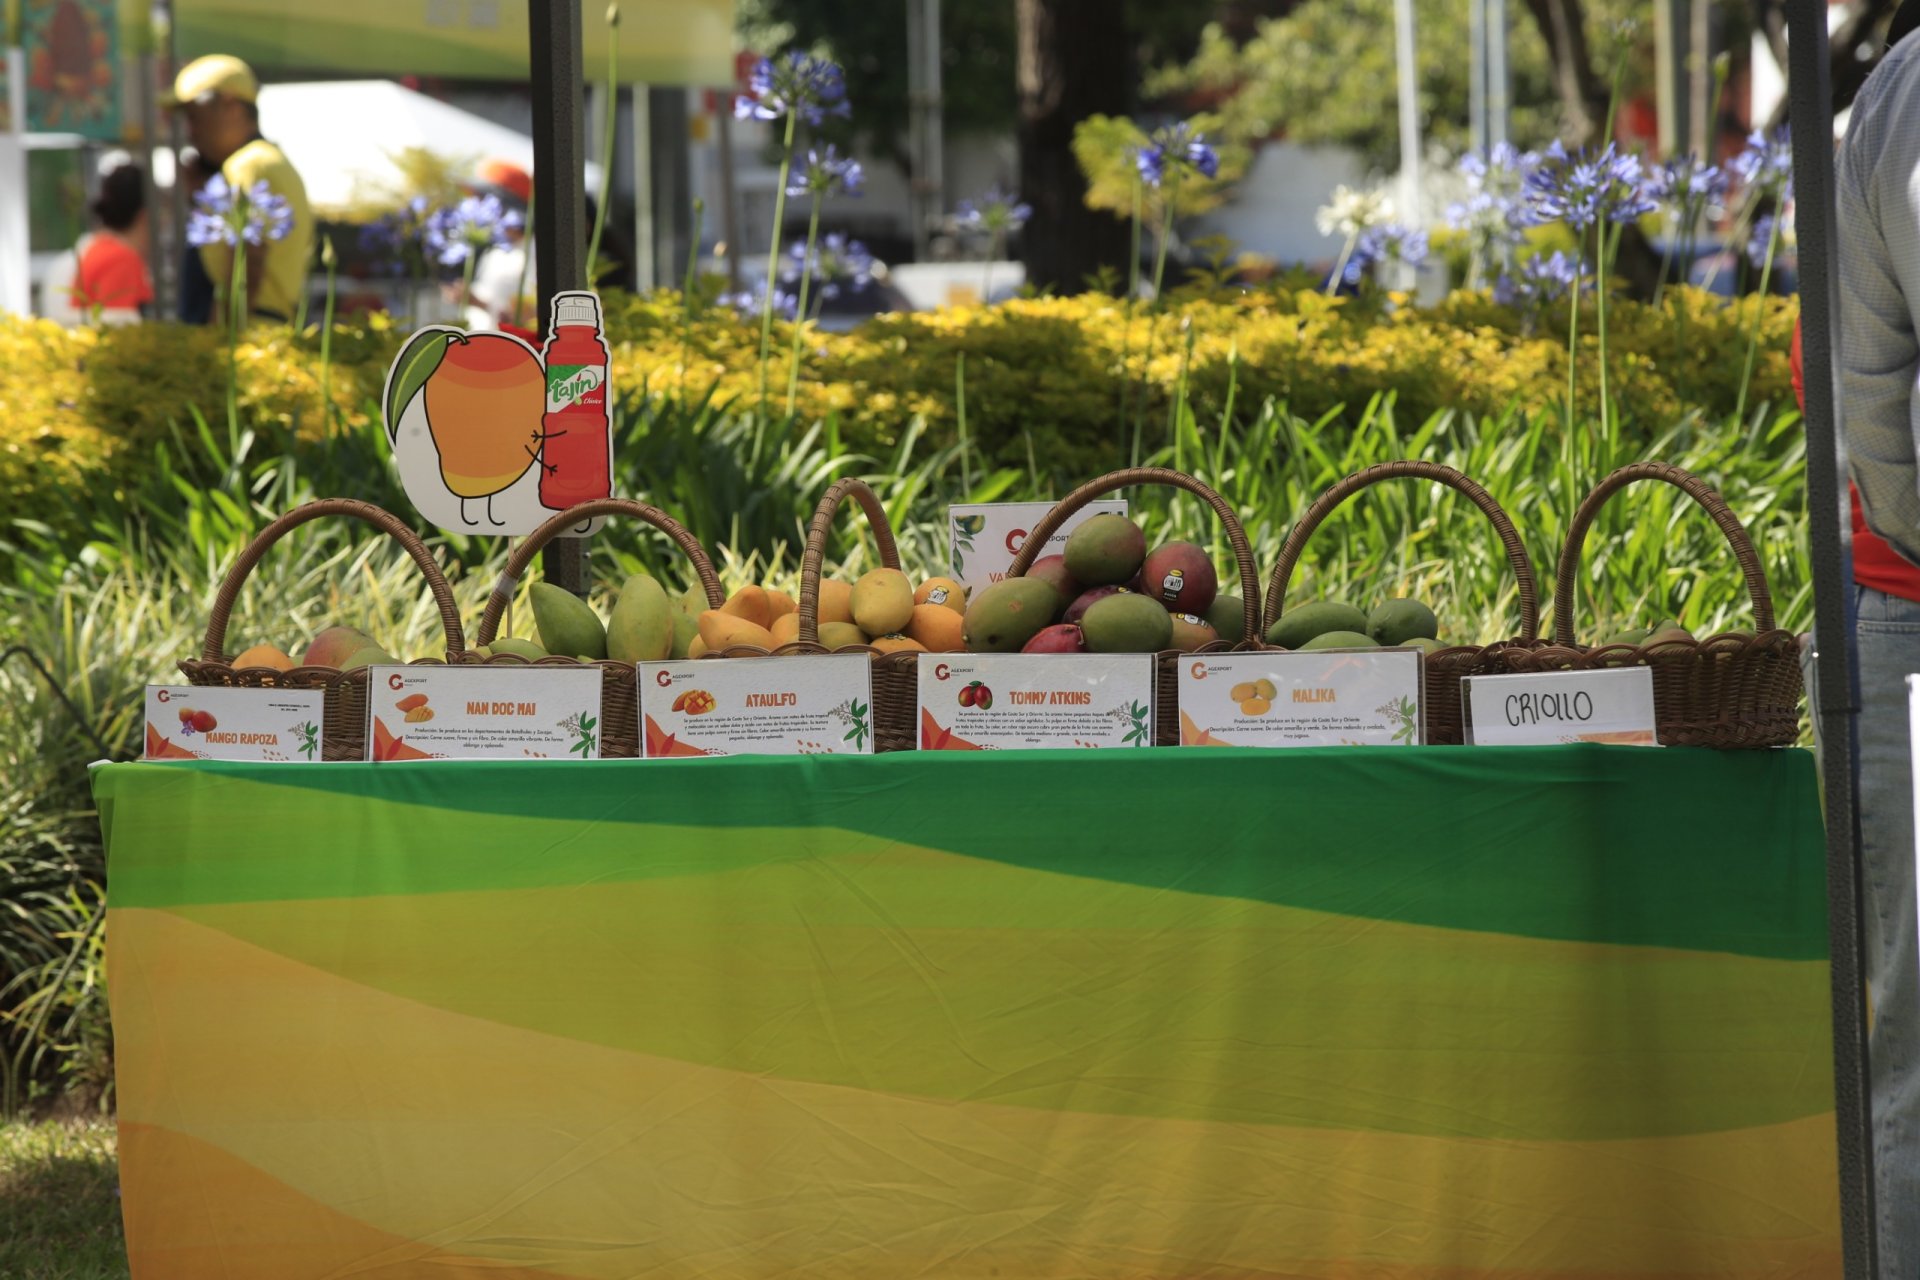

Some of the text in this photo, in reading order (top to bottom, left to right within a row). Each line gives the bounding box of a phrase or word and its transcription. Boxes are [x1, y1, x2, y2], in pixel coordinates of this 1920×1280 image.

[746, 692, 797, 708] ATAULFO
[1009, 691, 1091, 705] TOMMY ATKINS
[1292, 688, 1336, 703] MALIKA
[466, 701, 536, 716] NAN DOC MAI
[1505, 691, 1593, 727] CRIOLLO
[206, 733, 278, 746] MANGO RAPOZA
